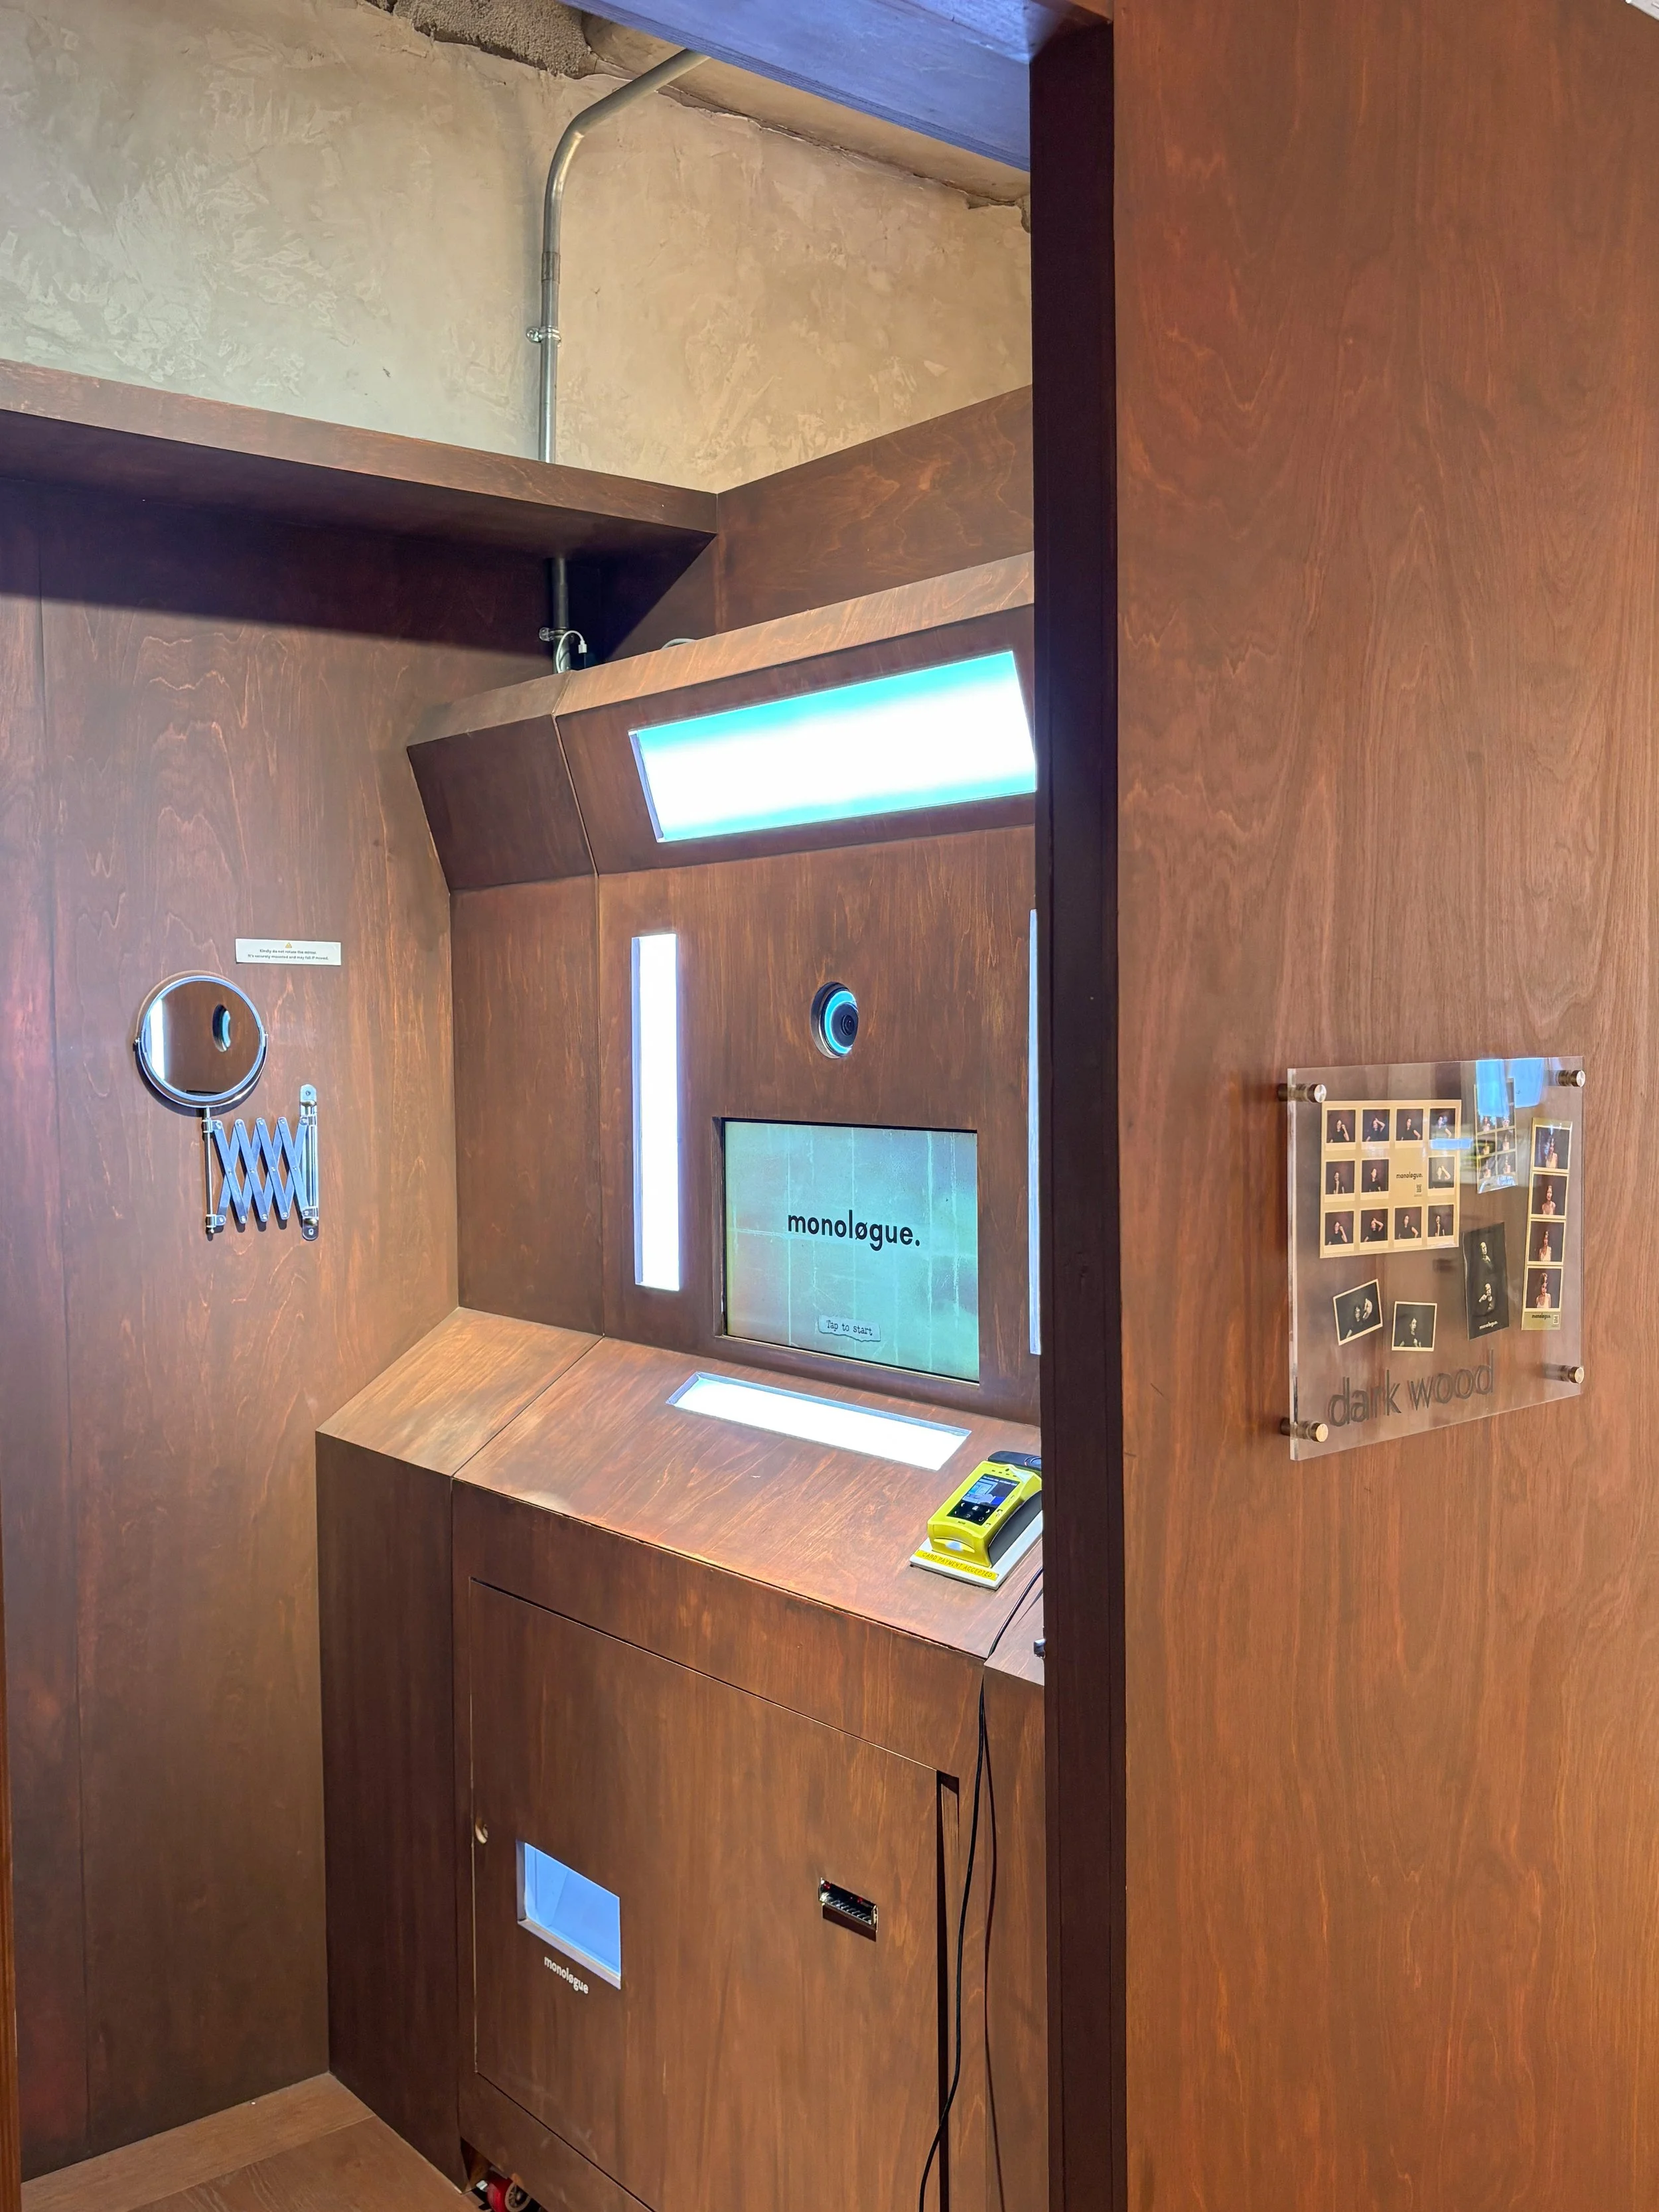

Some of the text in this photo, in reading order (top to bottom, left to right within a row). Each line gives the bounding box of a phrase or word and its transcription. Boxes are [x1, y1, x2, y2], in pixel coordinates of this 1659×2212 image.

[826, 1319, 873, 1336] Tap to start
[1328, 1348, 1494, 1427] dark wood
[937, 1556, 964, 1569] PAYMENT
[964, 1566, 993, 1578] ACCEPTED
